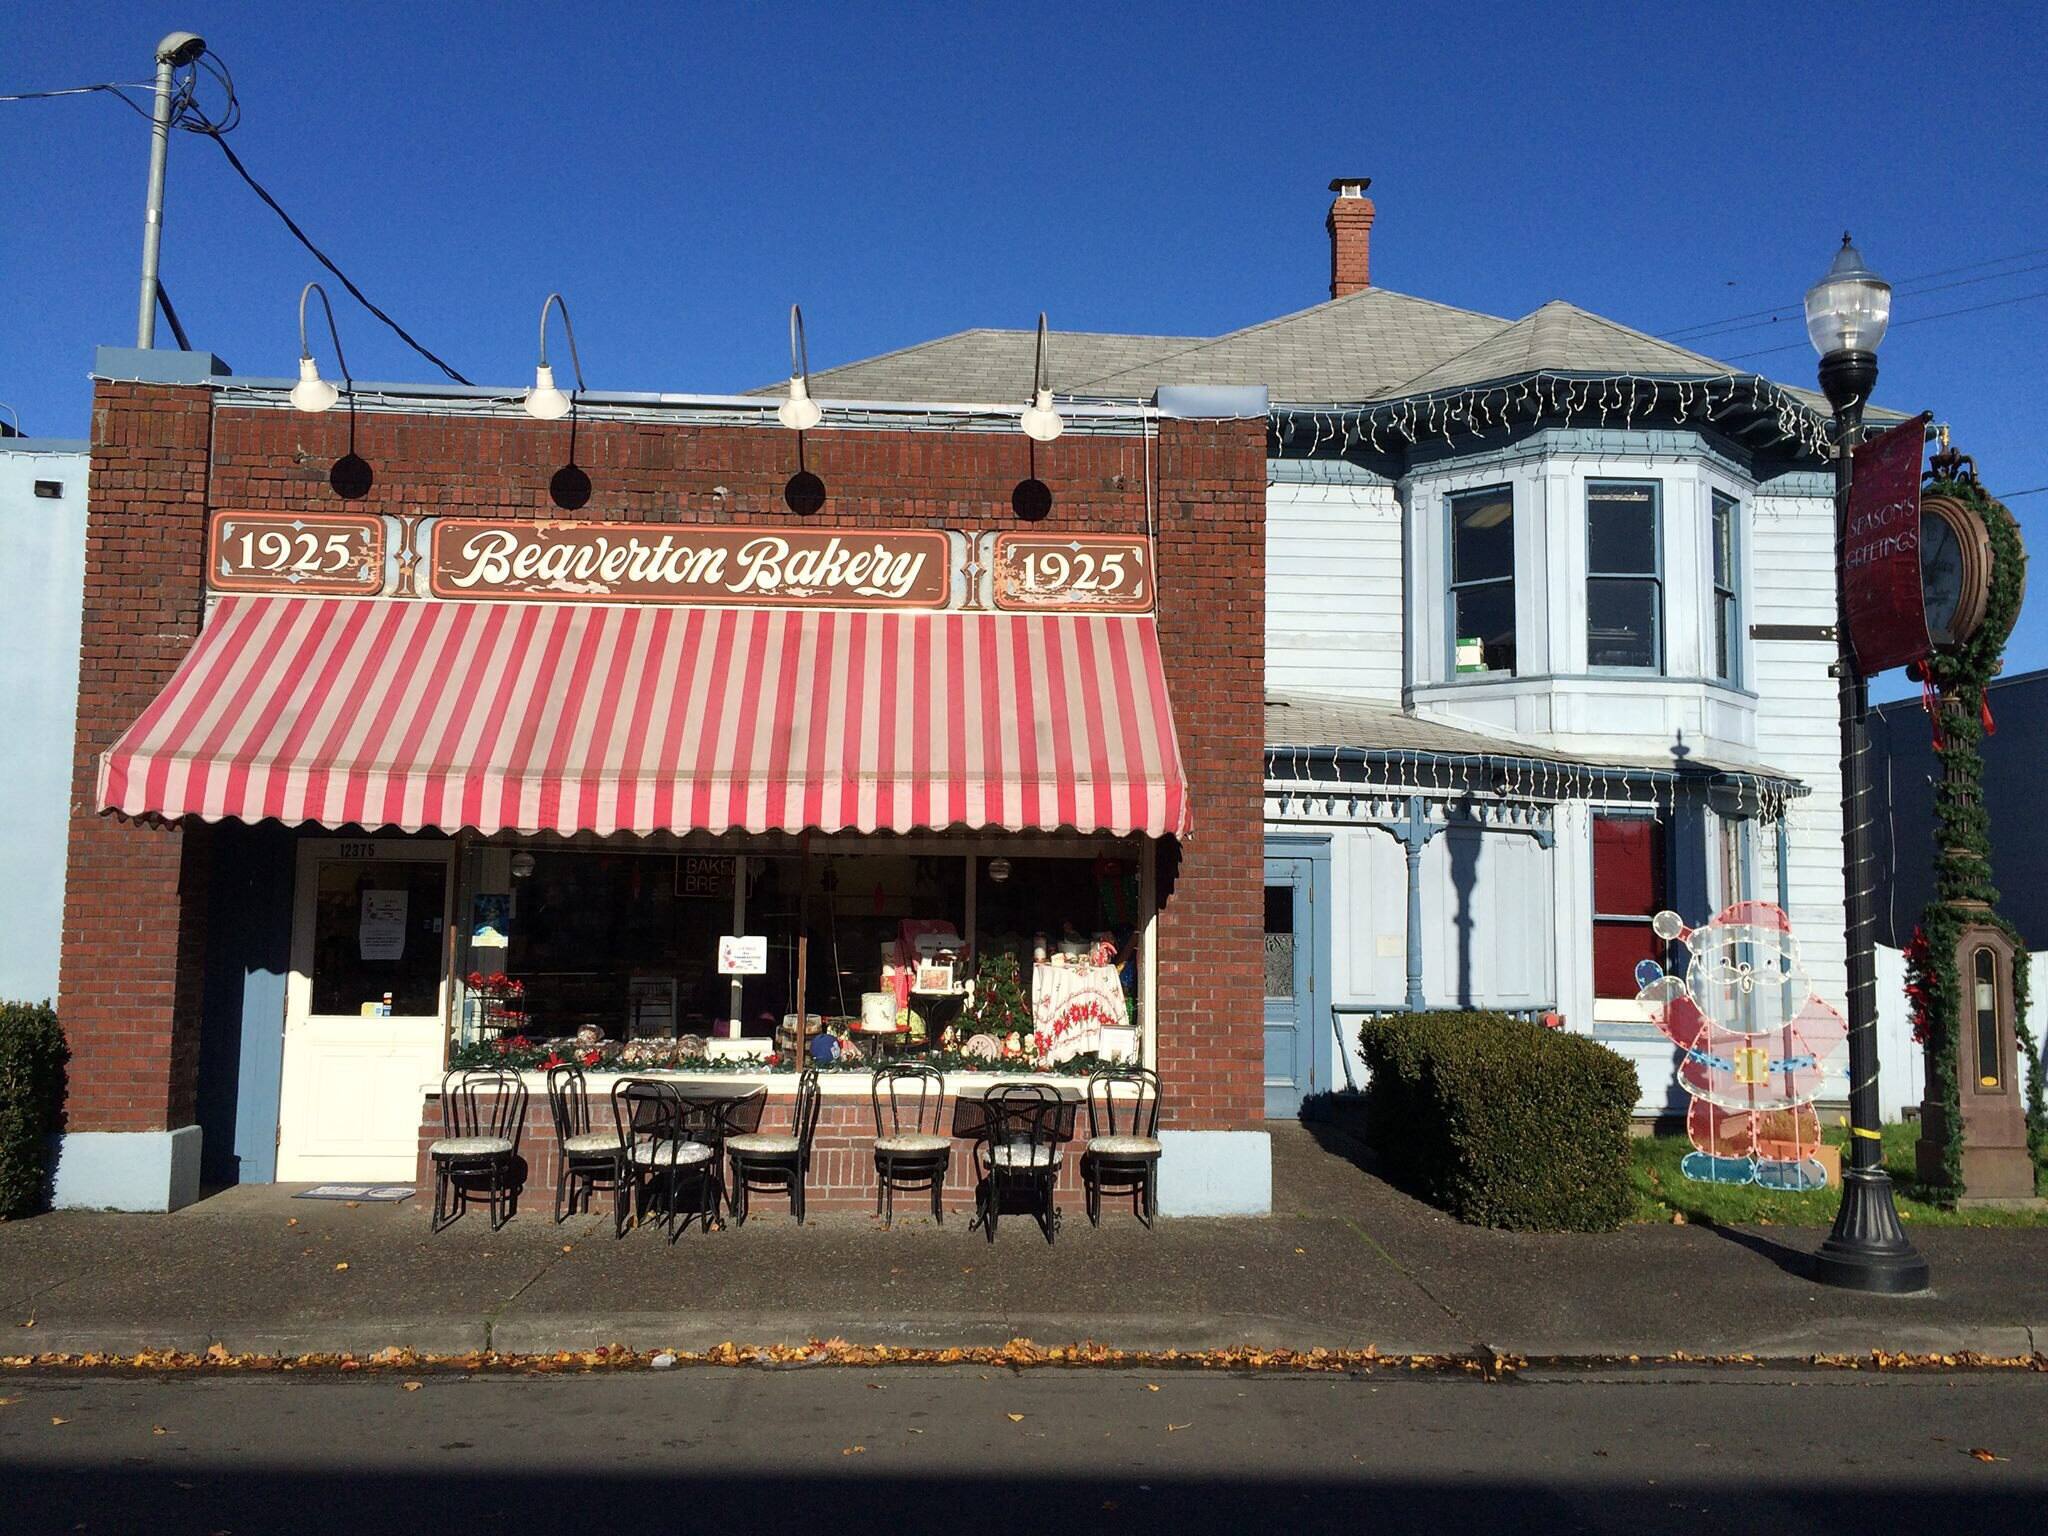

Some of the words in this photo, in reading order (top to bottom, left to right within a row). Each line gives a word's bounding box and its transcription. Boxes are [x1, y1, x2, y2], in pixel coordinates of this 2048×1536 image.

[1850, 496, 1914, 537] SEASON'S
[238, 531, 351, 571] 1925
[450, 529, 724, 587] Beaverton
[725, 537, 927, 598] Bakery
[1845, 527, 1918, 569] GREETINGS
[1022, 552, 1125, 591] 1925
[340, 843, 375, 857] 12375
